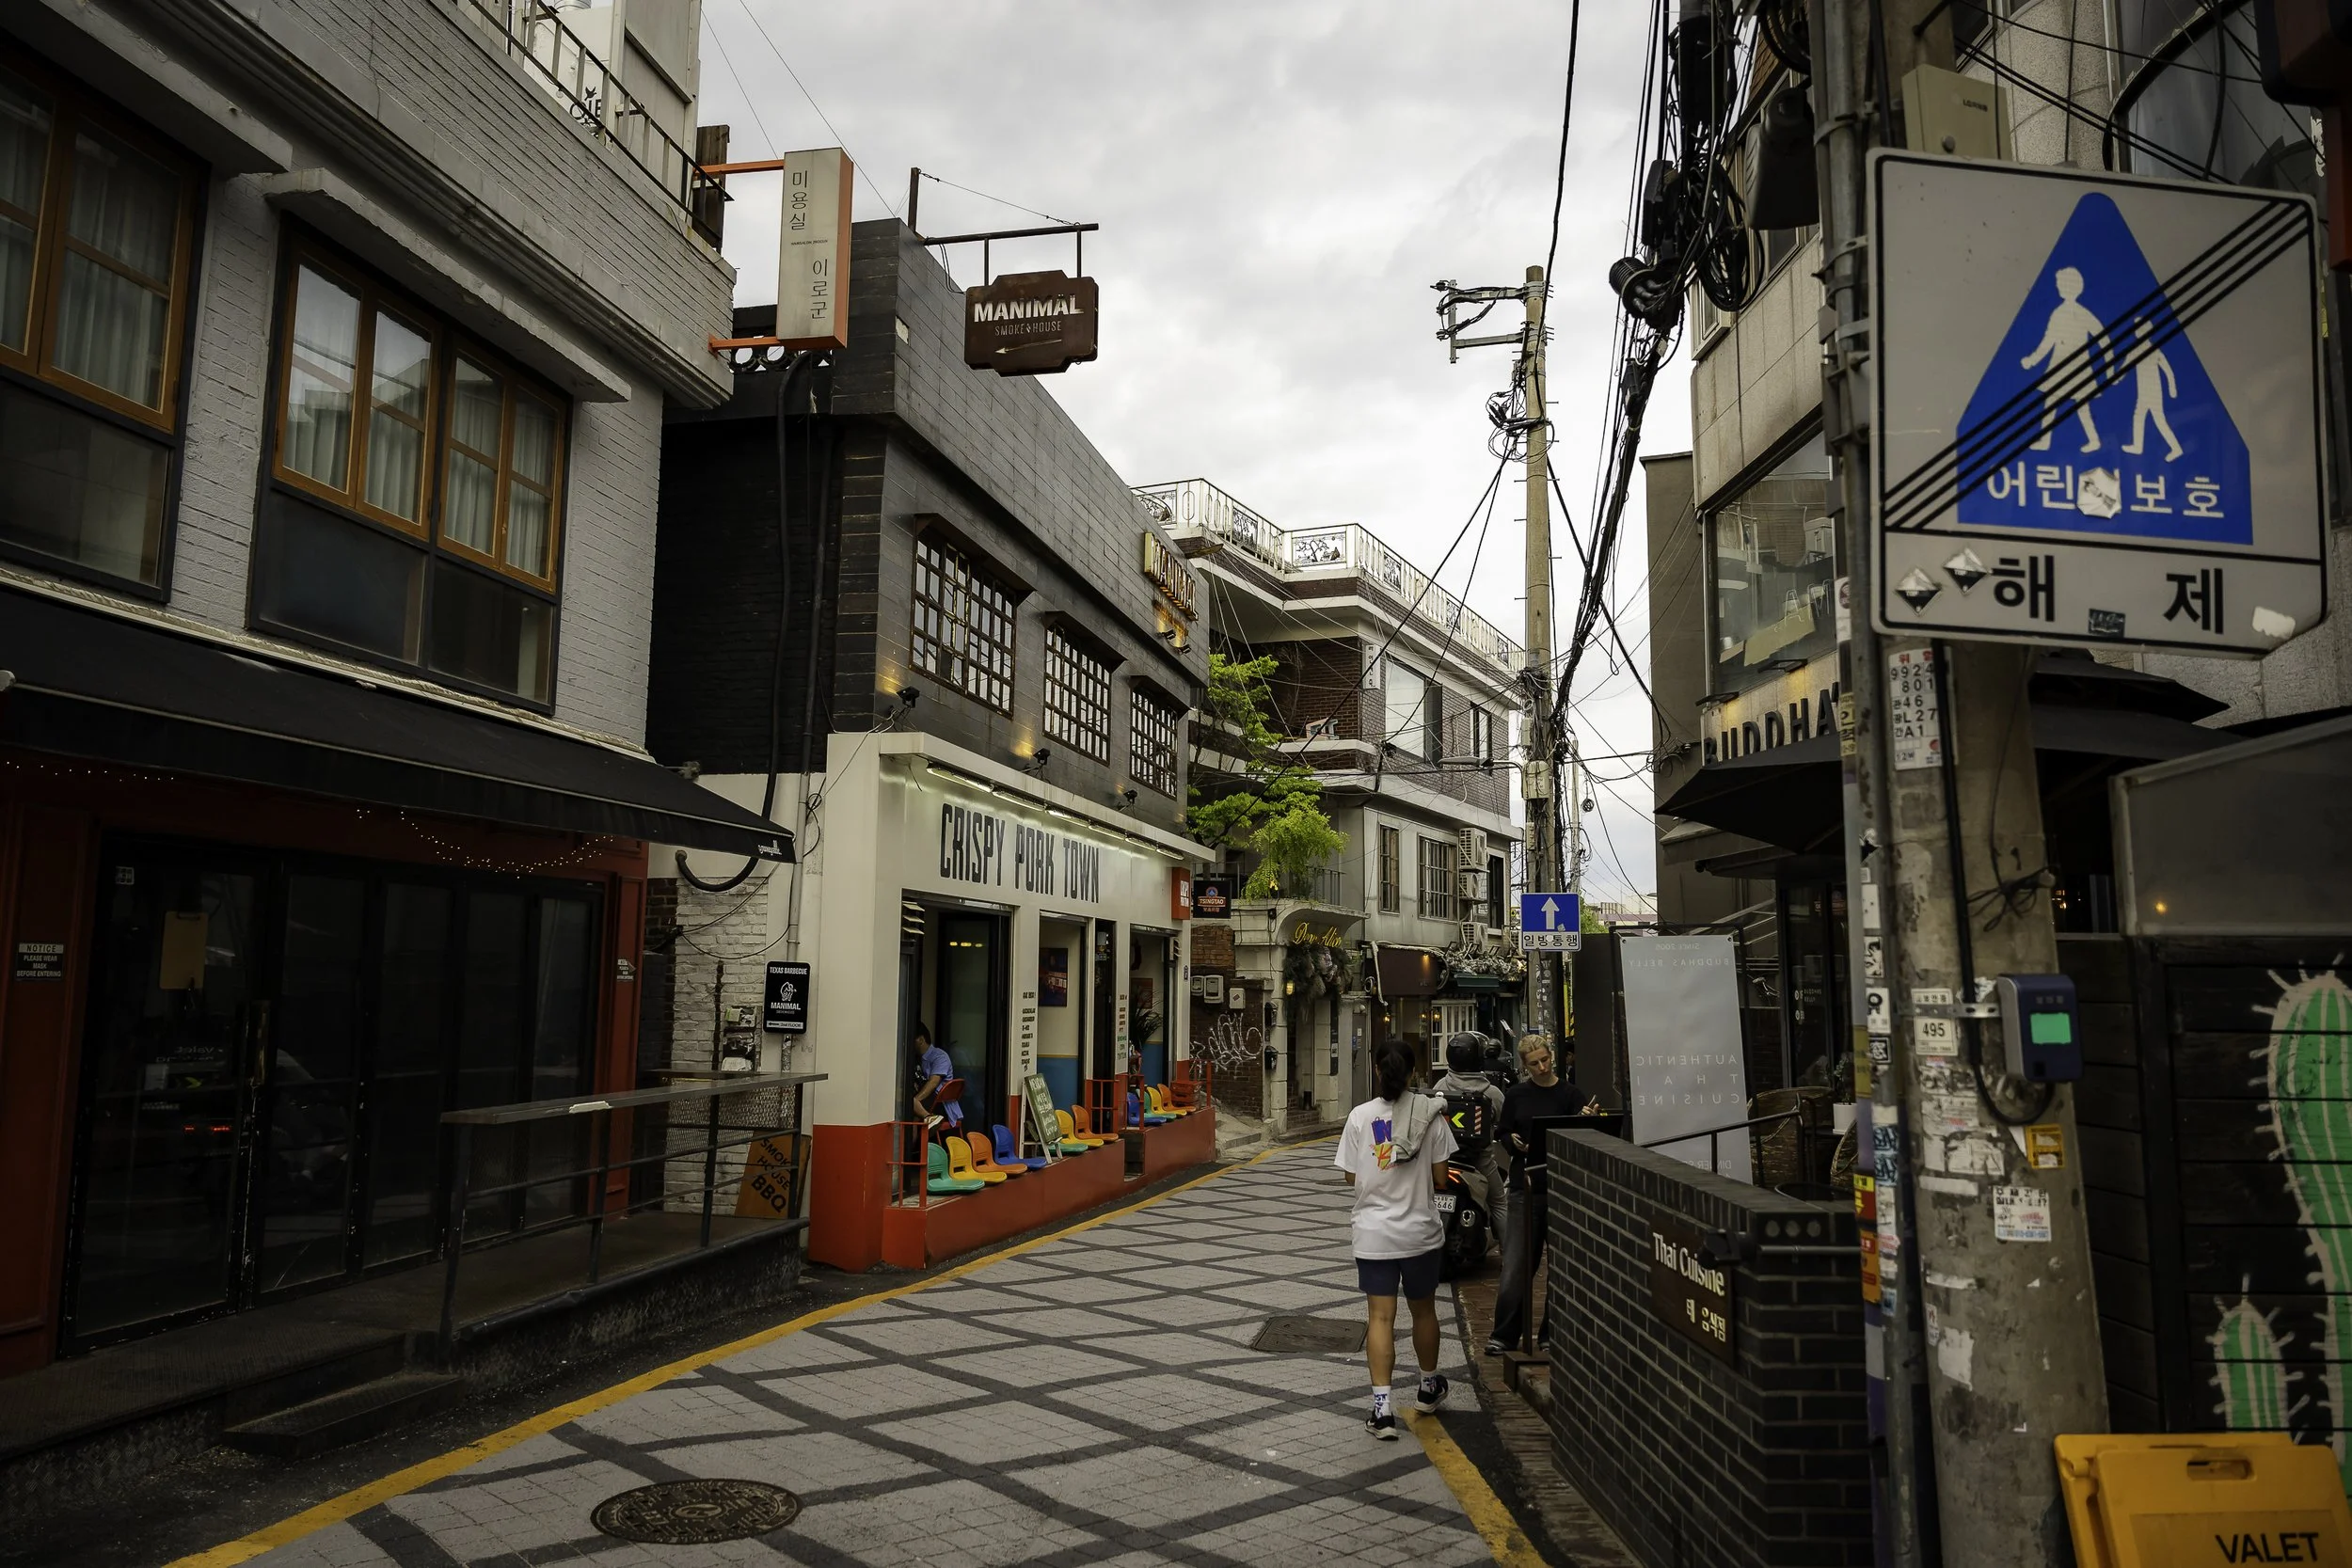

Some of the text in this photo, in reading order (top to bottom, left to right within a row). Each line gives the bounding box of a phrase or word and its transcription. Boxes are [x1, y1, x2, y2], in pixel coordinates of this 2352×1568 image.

[789, 170, 808, 230] 미용실
[810, 259, 829, 320] 이로군
[994, 321, 1062, 337] SMOKE HOUSE
[1987, 461, 2224, 518] 어린보호
[940, 802, 1100, 904] CRISPY PORK TOWN
[26, 944, 56, 953] NOTICE
[1523, 934, 1578, 947] 일방통행
[770, 966, 808, 975] TEXAS BARBECUE
[770, 1002, 802, 1010] MANIMAL
[1922, 1022, 1946, 1037] 495
[760, 1138, 793, 1166] SMOK
[751, 1175, 787, 1213] BBQ
[1652, 1231, 1725, 1297] Thai Cuisine
[2215, 1532, 2320, 1564] VALET
